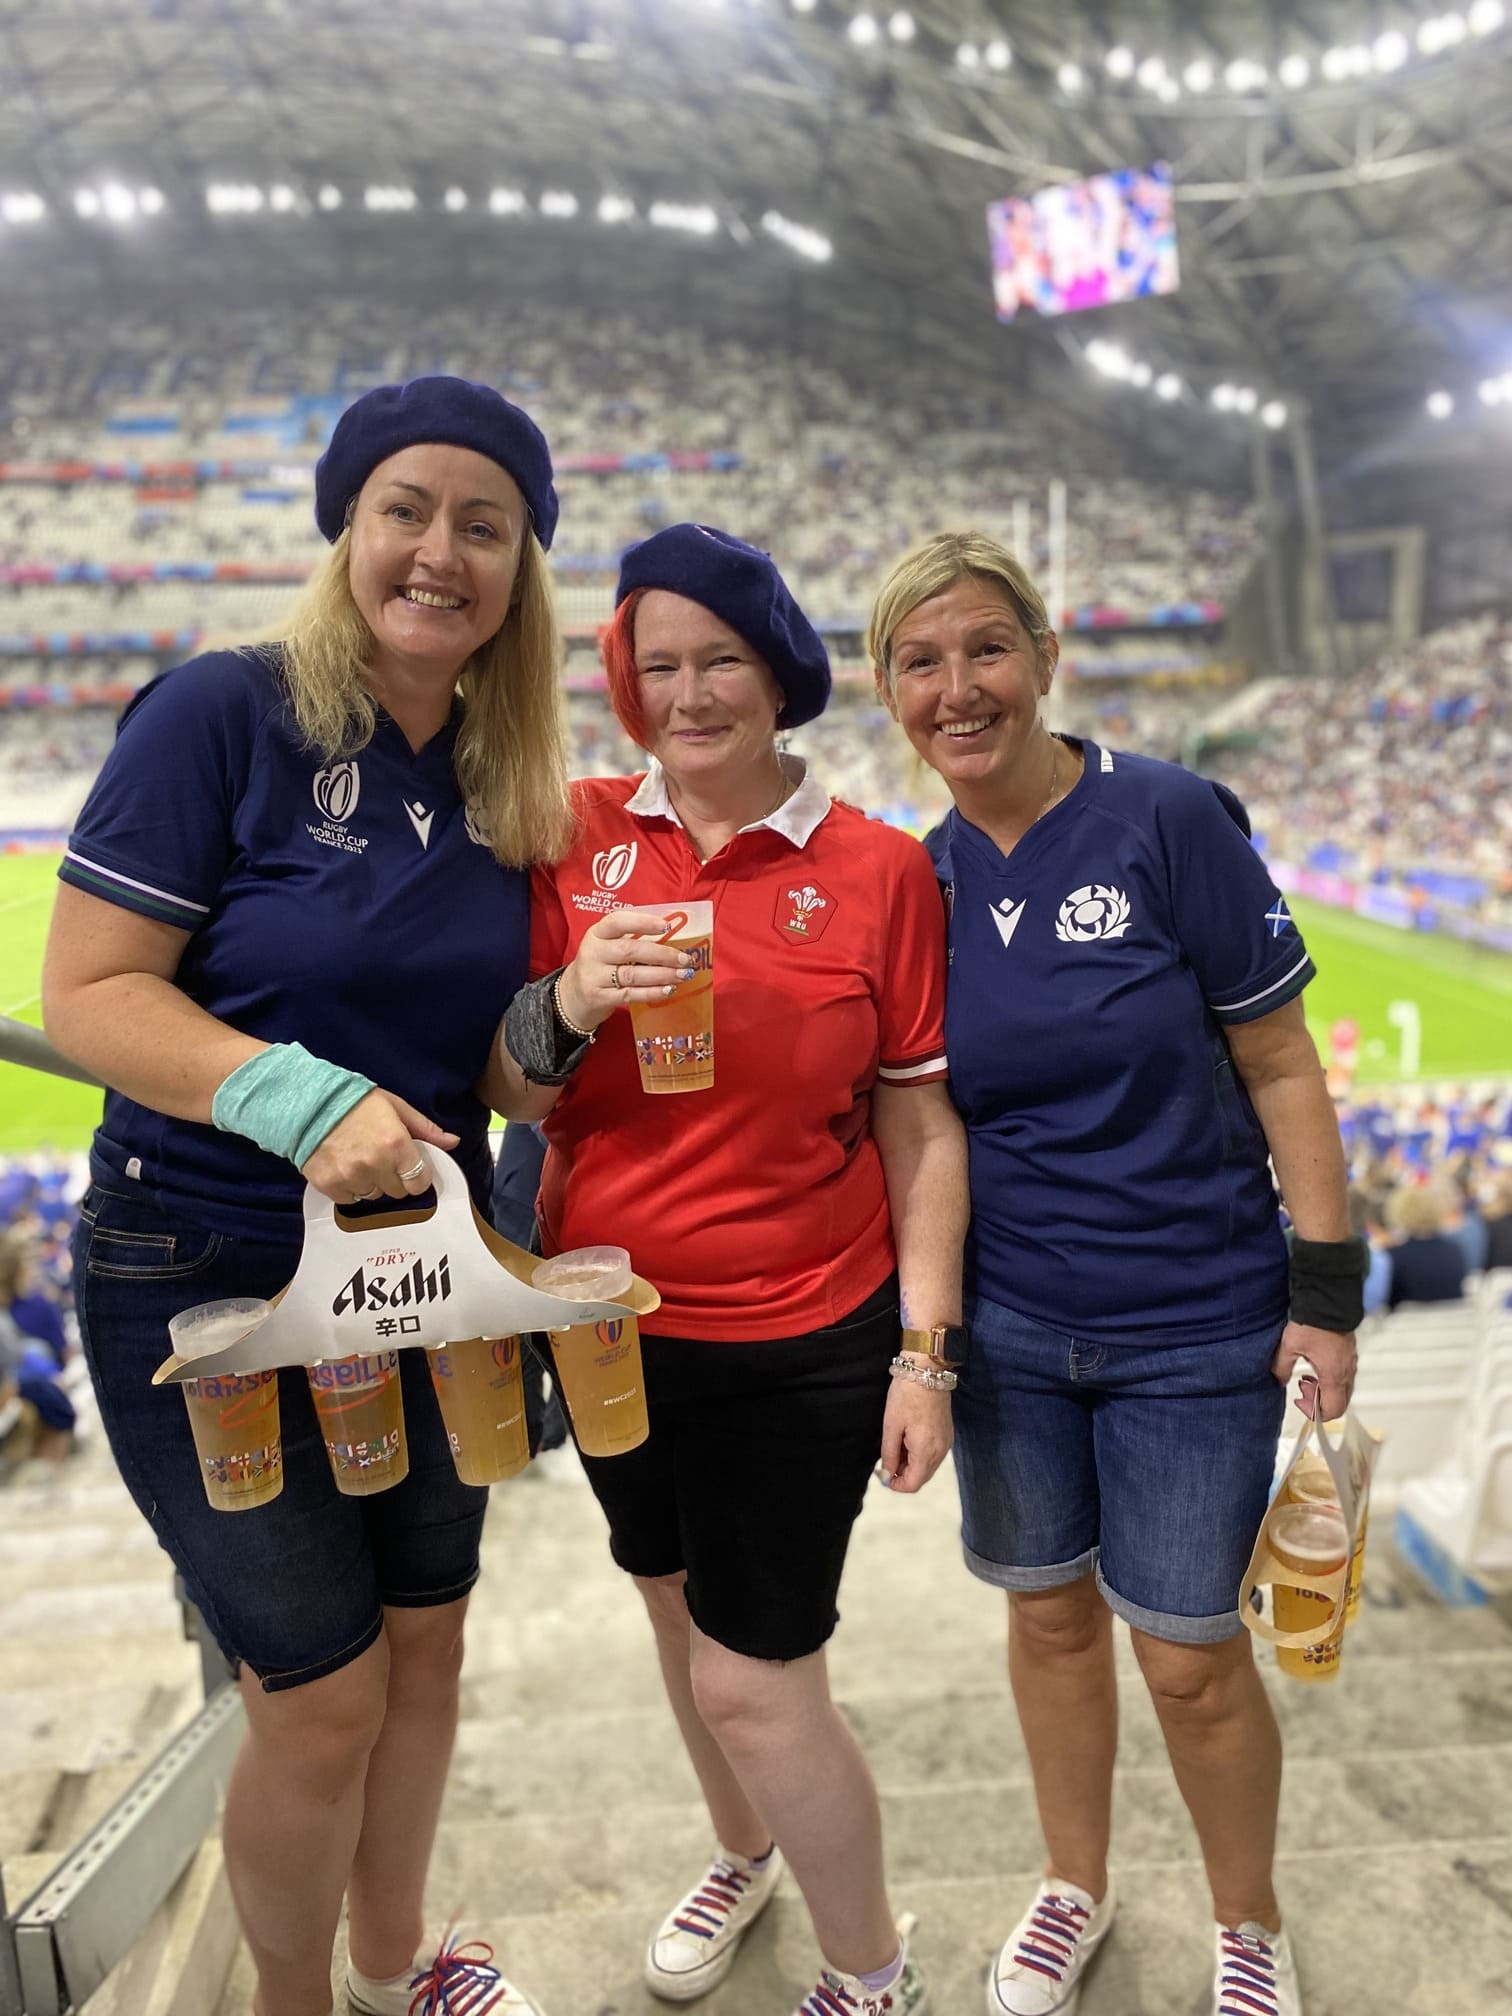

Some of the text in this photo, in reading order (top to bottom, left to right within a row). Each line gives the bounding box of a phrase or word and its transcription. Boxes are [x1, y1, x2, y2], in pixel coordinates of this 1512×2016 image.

[322, 821, 348, 834] RUGBY
[306, 824, 369, 848] WORLD CUP
[313, 835, 362, 854] FRANCE 2023
[572, 894, 611, 907] WORLD
[592, 890, 617, 900] RUGBY
[575, 904, 603, 913] FRANCE
[789, 919, 807, 930] WRU
[332, 1253, 452, 1316] Asahi
[375, 1315, 421, 1337] 辛口
